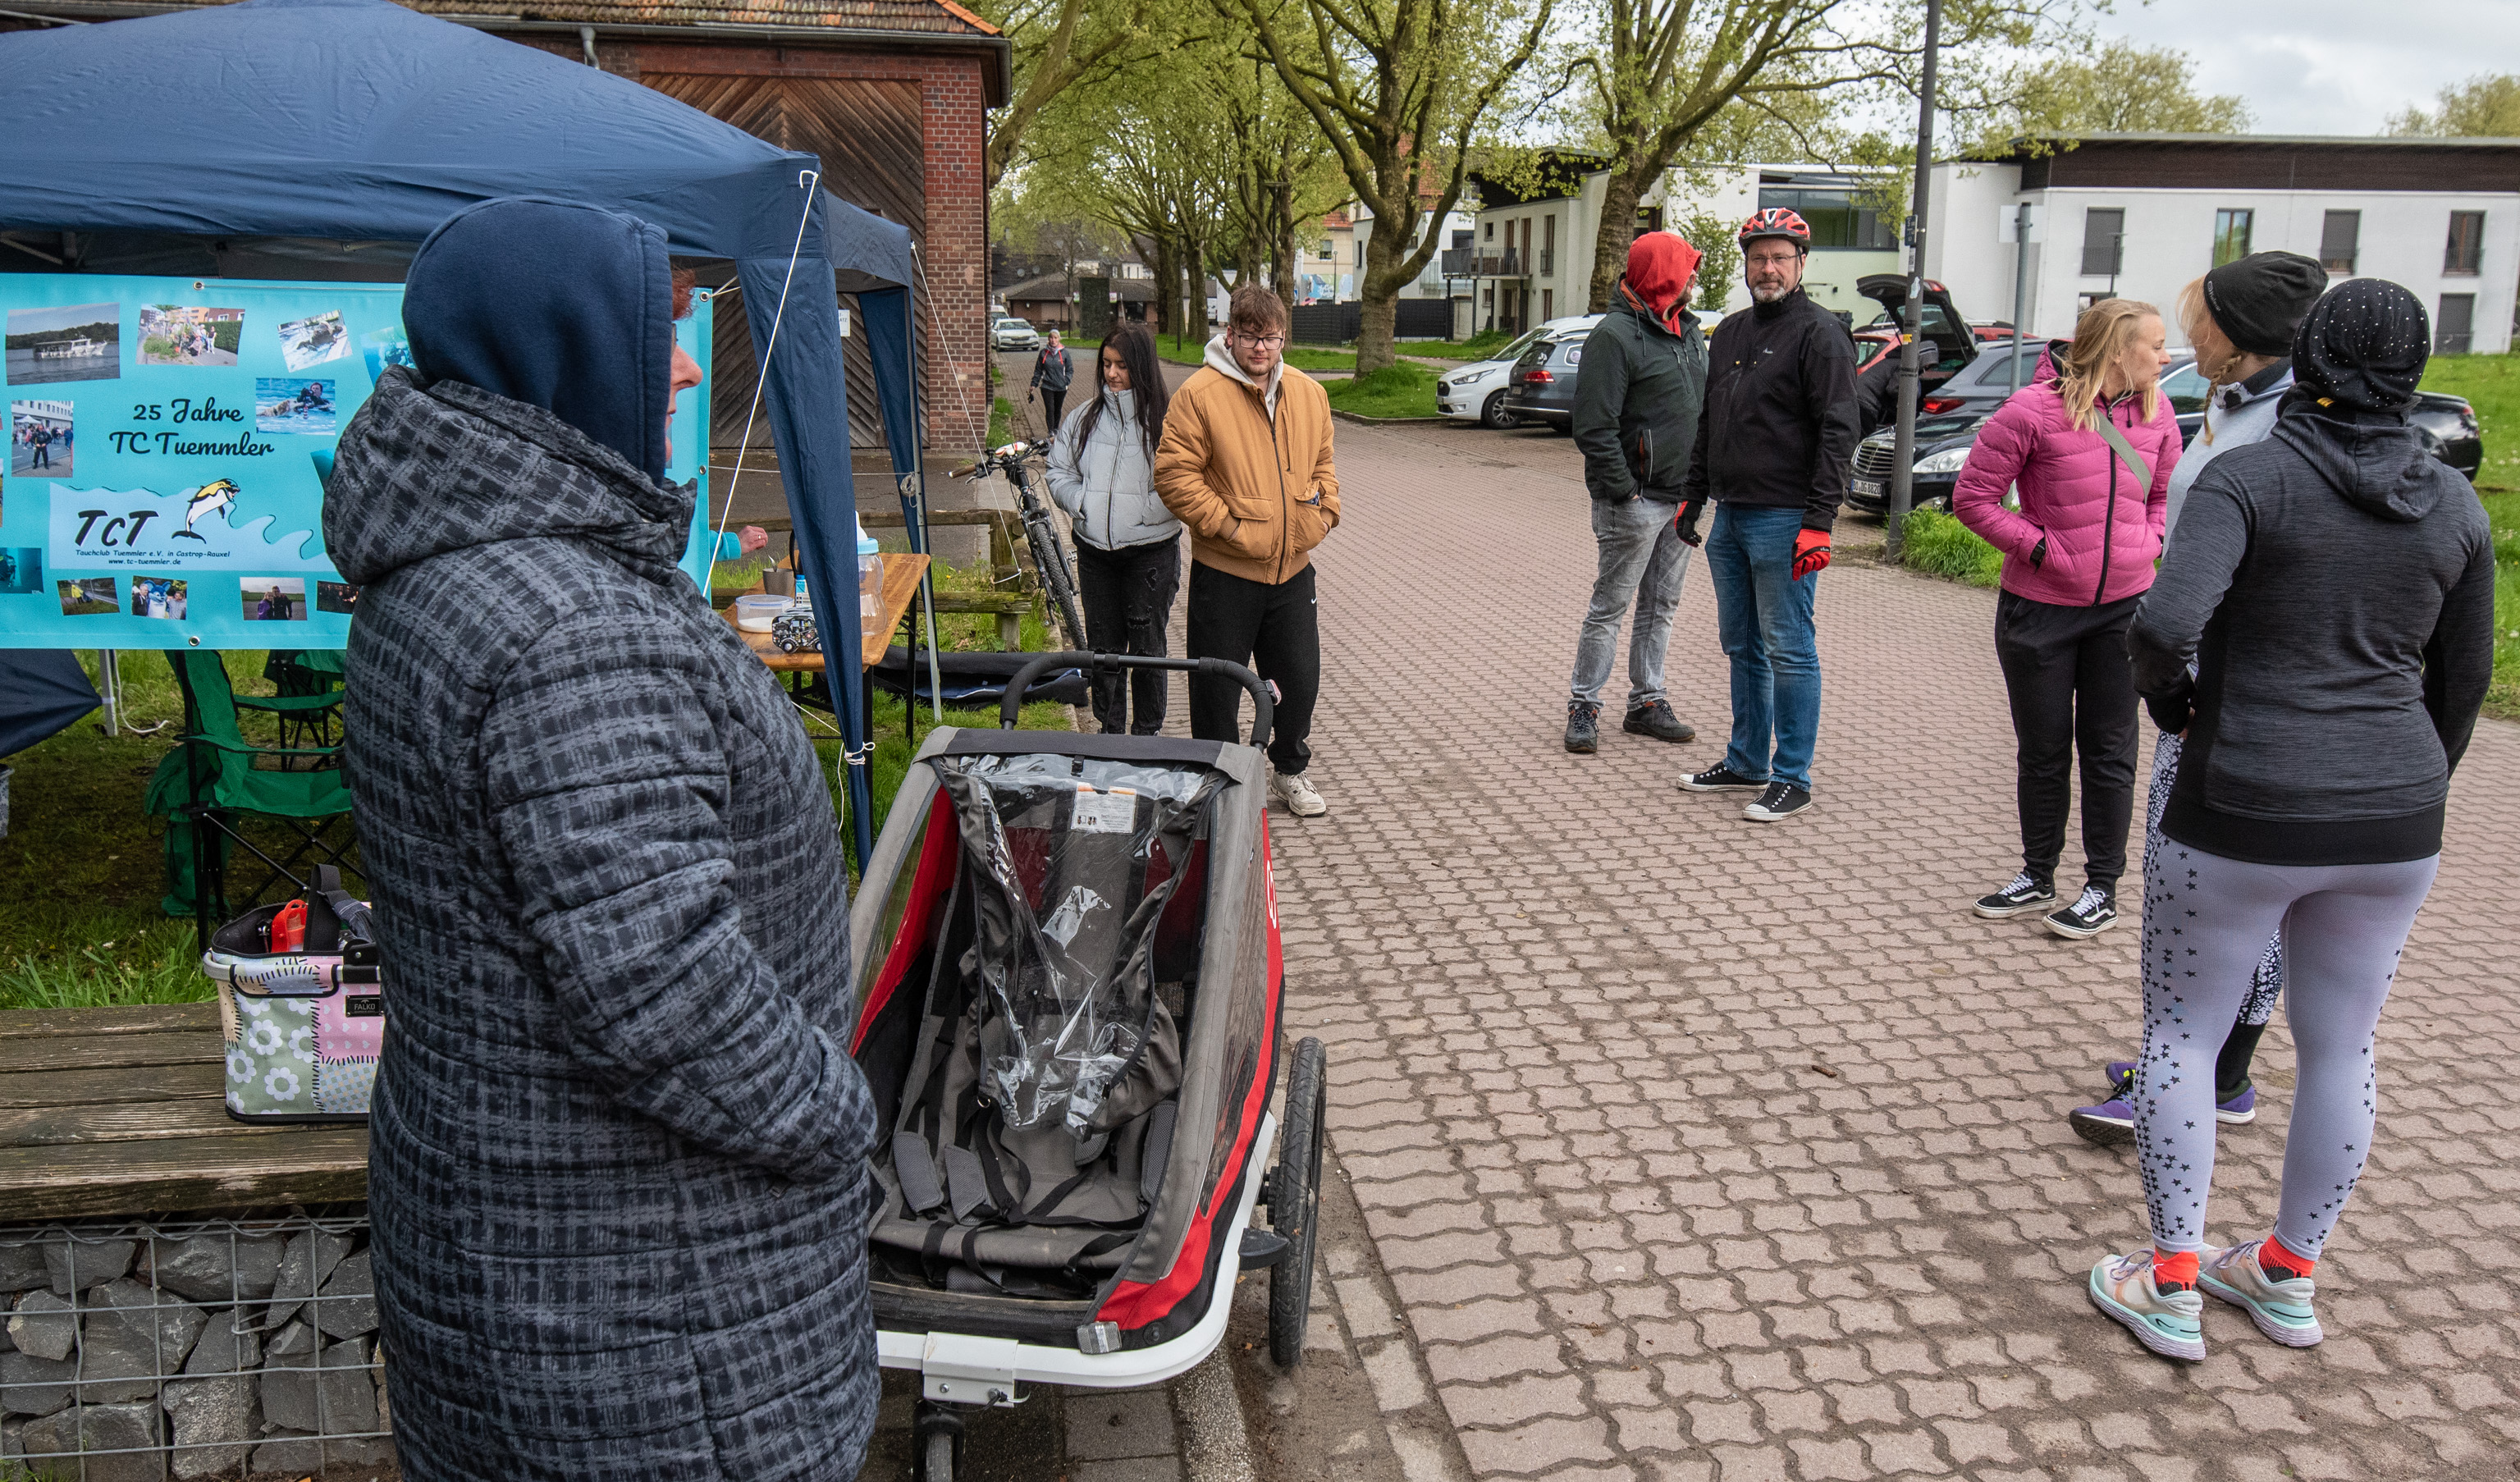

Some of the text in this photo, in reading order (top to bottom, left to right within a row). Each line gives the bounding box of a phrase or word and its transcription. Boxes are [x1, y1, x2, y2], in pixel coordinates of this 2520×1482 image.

[133, 396, 245, 423] 25 Jahre
[108, 432, 275, 457] TC Tuemmler
